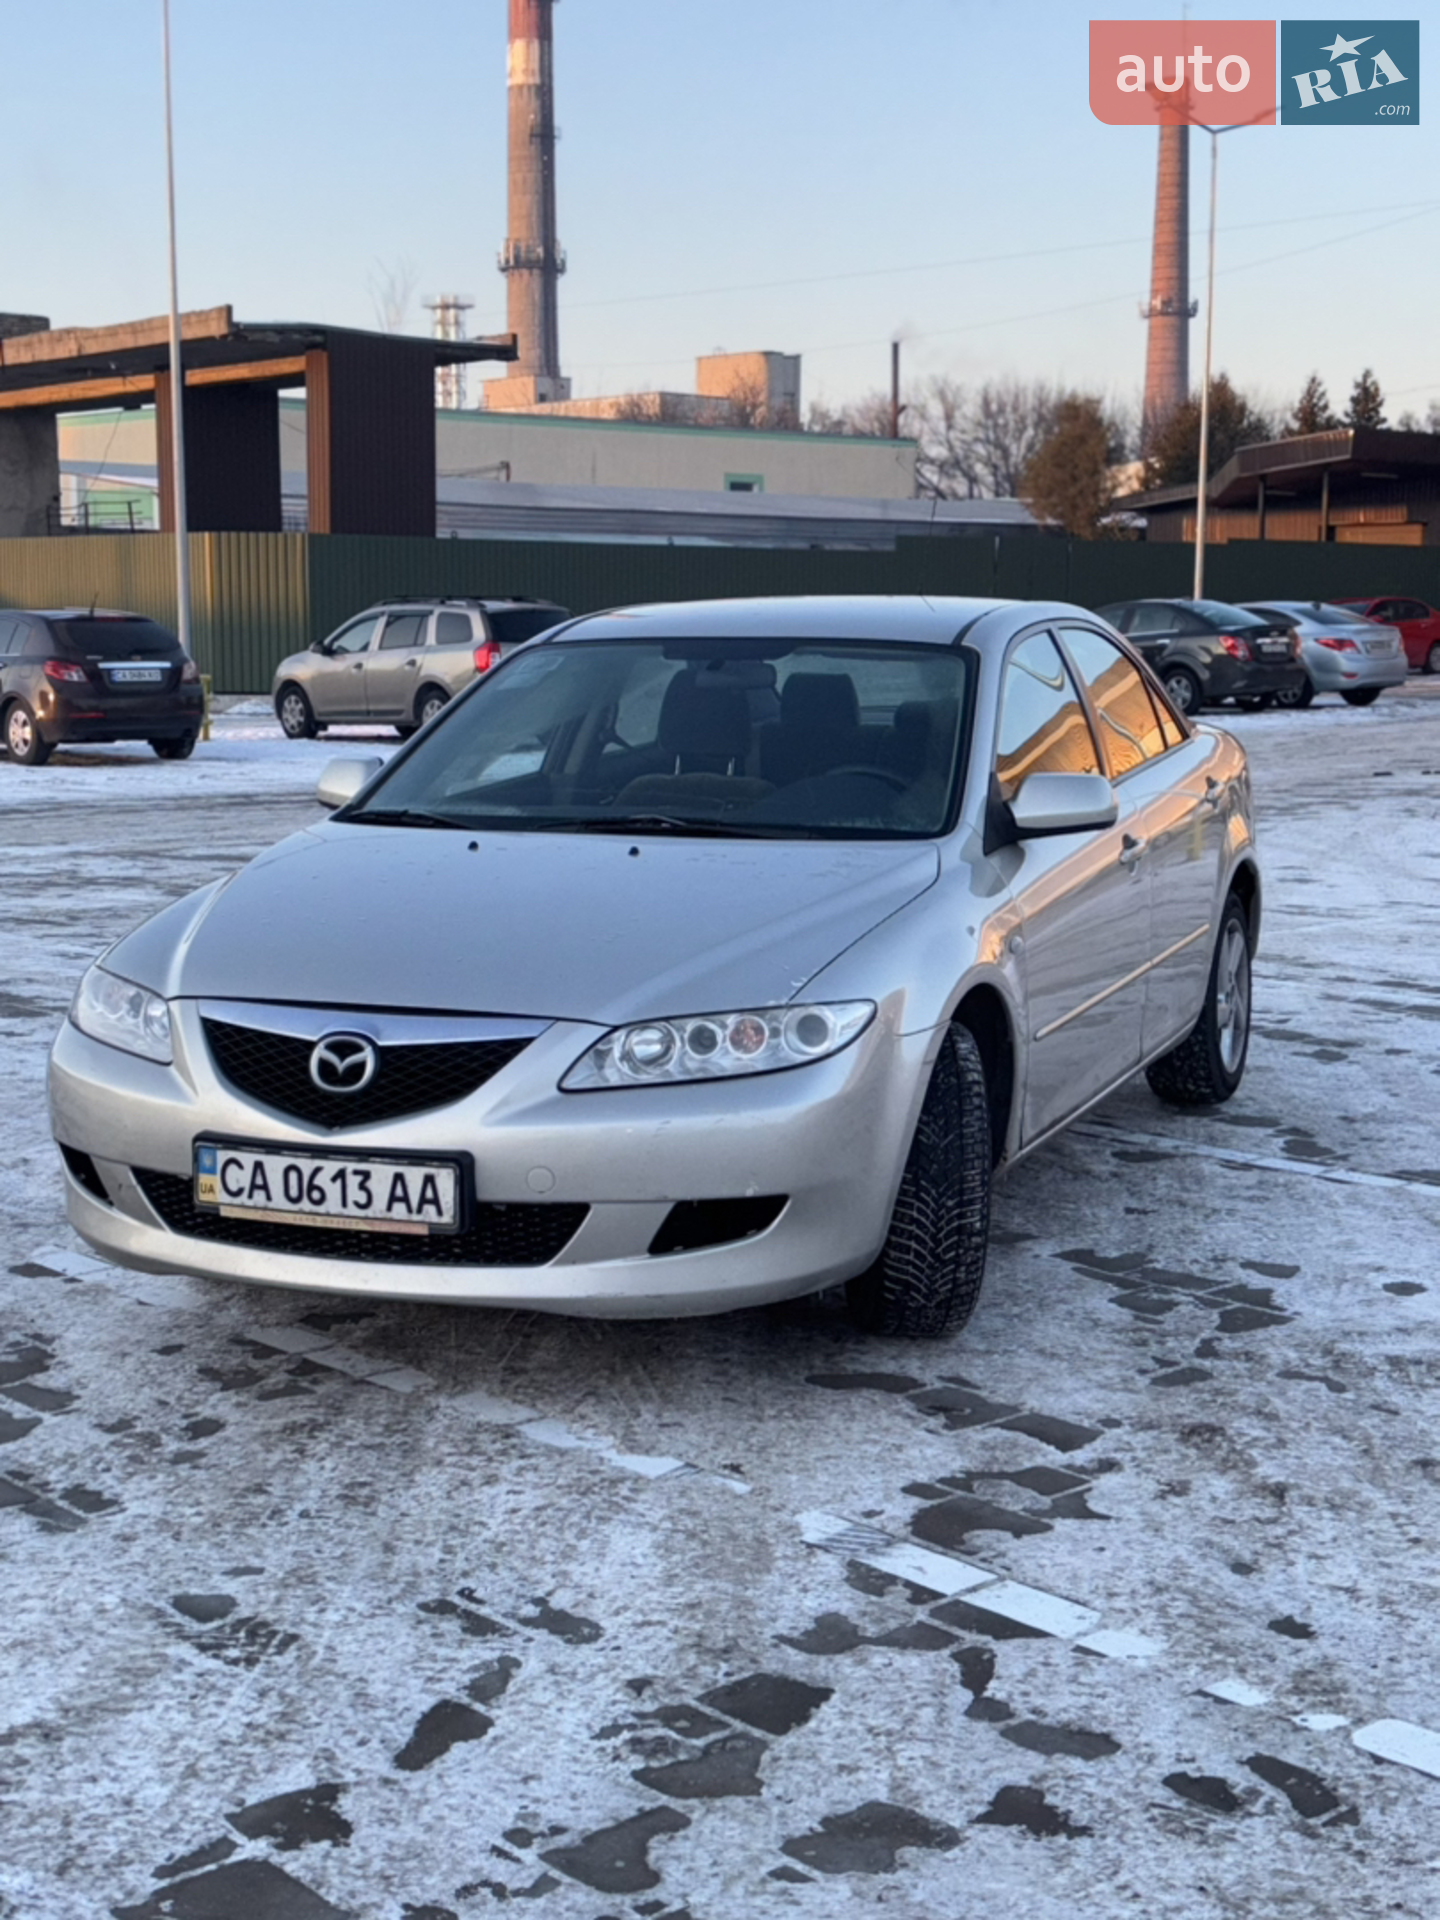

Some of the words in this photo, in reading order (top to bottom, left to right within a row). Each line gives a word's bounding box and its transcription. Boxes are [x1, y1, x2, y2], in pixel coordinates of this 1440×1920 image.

[200, 1182, 216, 1195] UA
[220, 1157, 273, 1203] CA
[283, 1163, 374, 1211] 0613
[386, 1171, 444, 1218] AA
